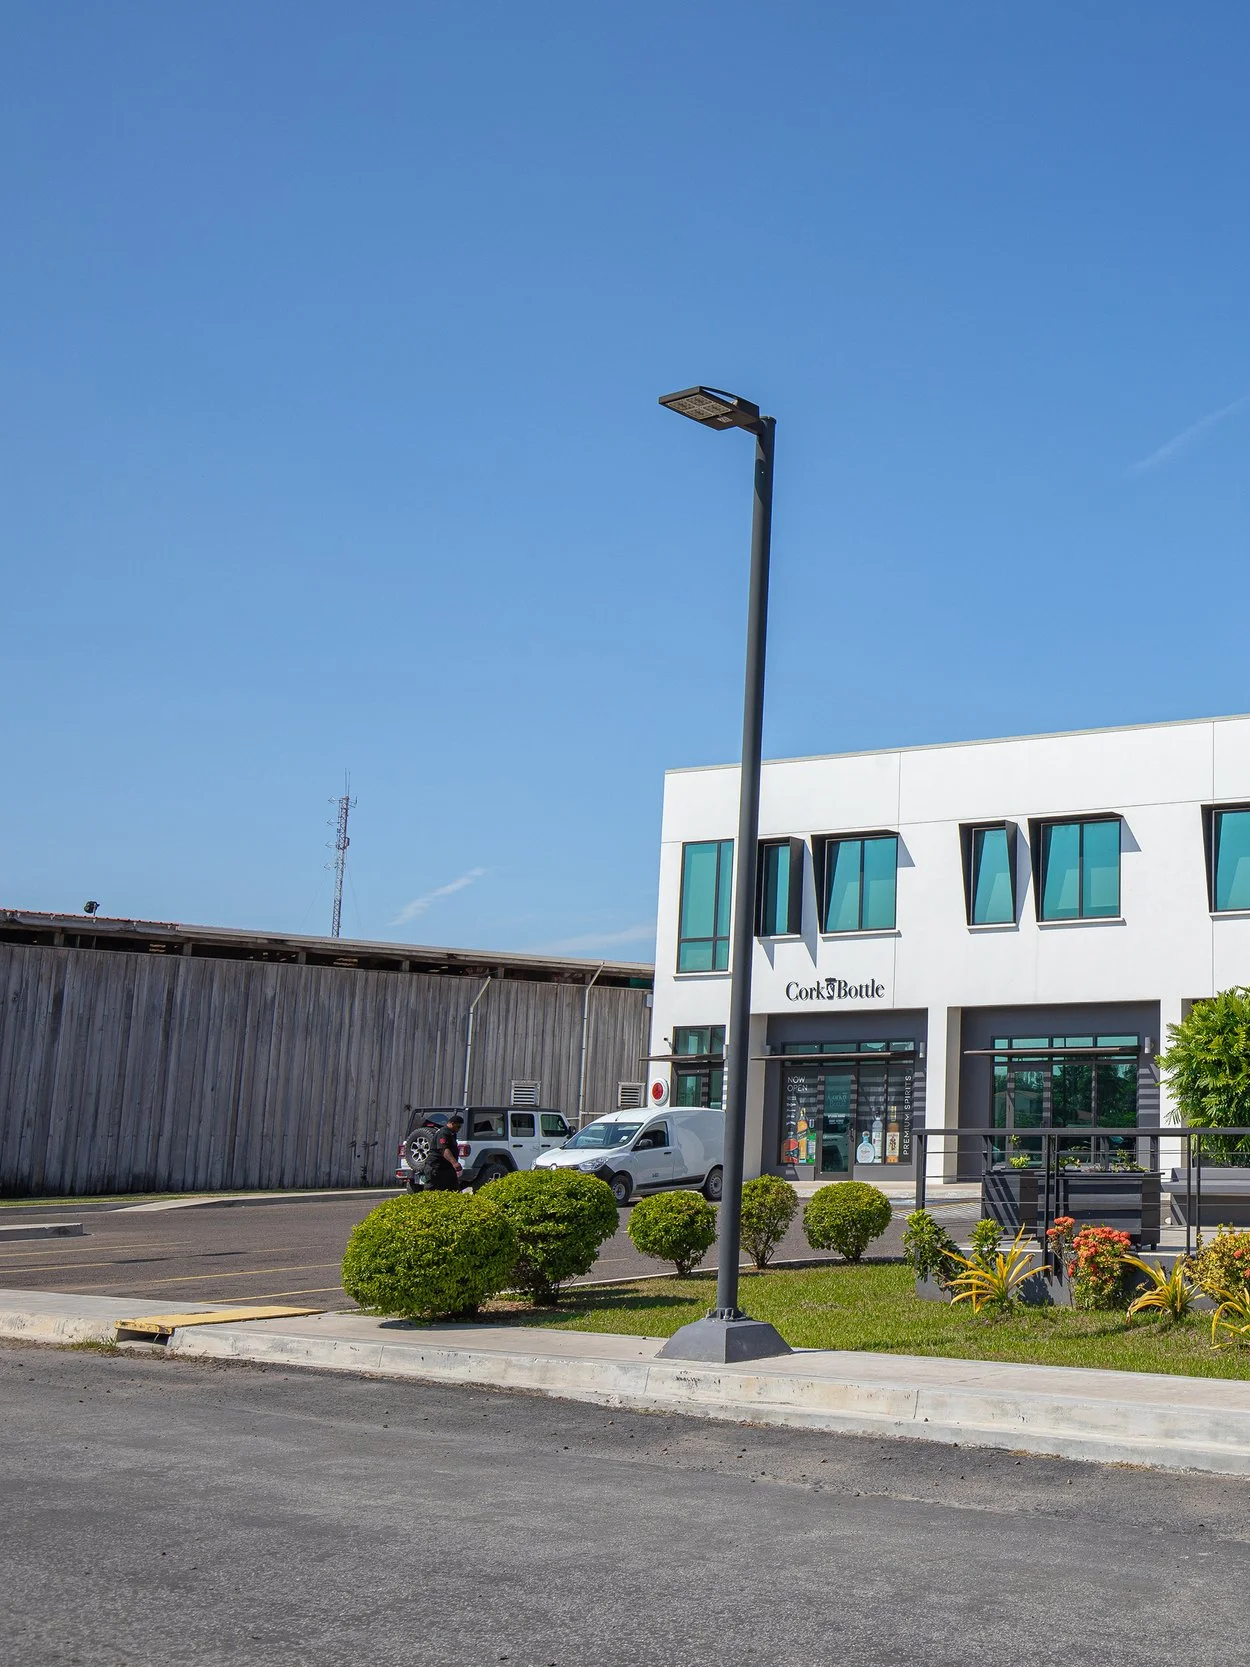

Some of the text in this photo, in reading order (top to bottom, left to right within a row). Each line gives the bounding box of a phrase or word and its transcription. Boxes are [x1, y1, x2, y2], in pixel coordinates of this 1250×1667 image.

[785, 978, 885, 1001] Cork Bottle
[787, 1075, 806, 1083] NOW
[904, 1075, 912, 1109] SPIRITS
